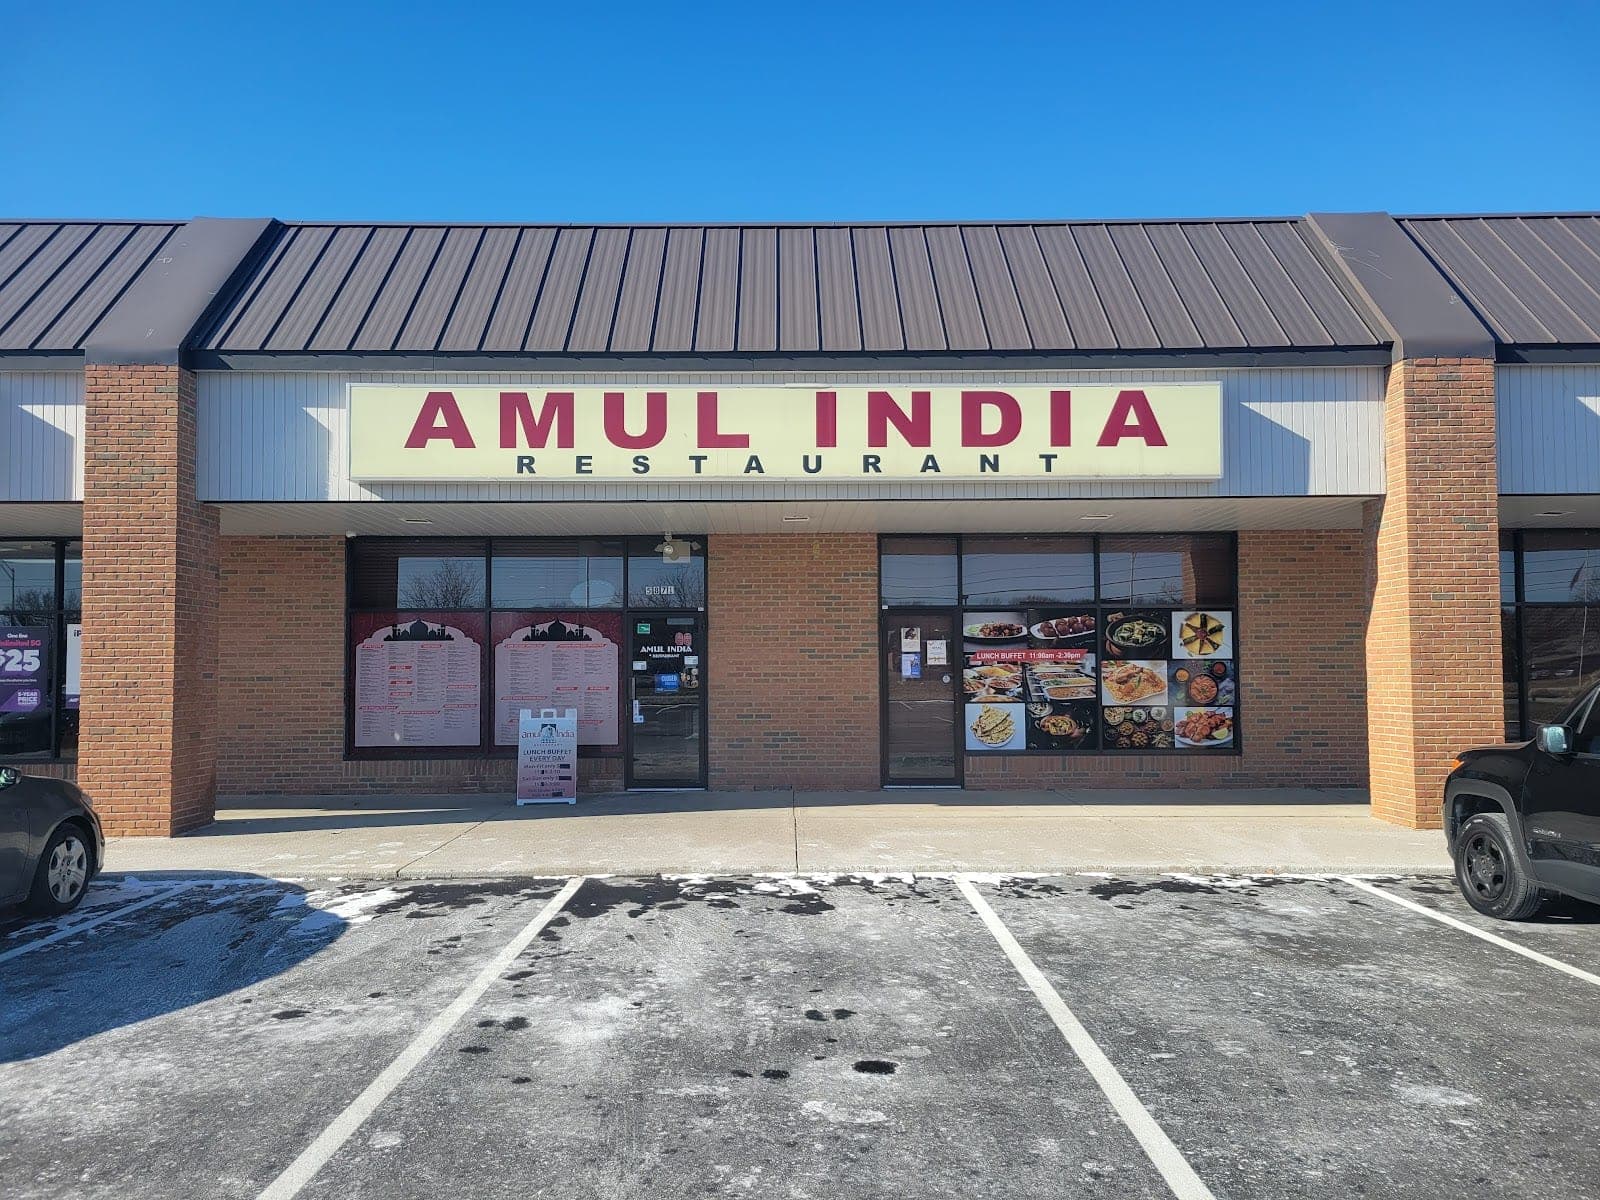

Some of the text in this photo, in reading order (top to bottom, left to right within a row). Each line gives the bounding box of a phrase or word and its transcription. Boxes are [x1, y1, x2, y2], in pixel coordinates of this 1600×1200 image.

[403, 389, 1168, 449] AMUL INDIA
[515, 453, 1058, 475] RESTAURANT
[976, 652, 999, 660] LUNCH
